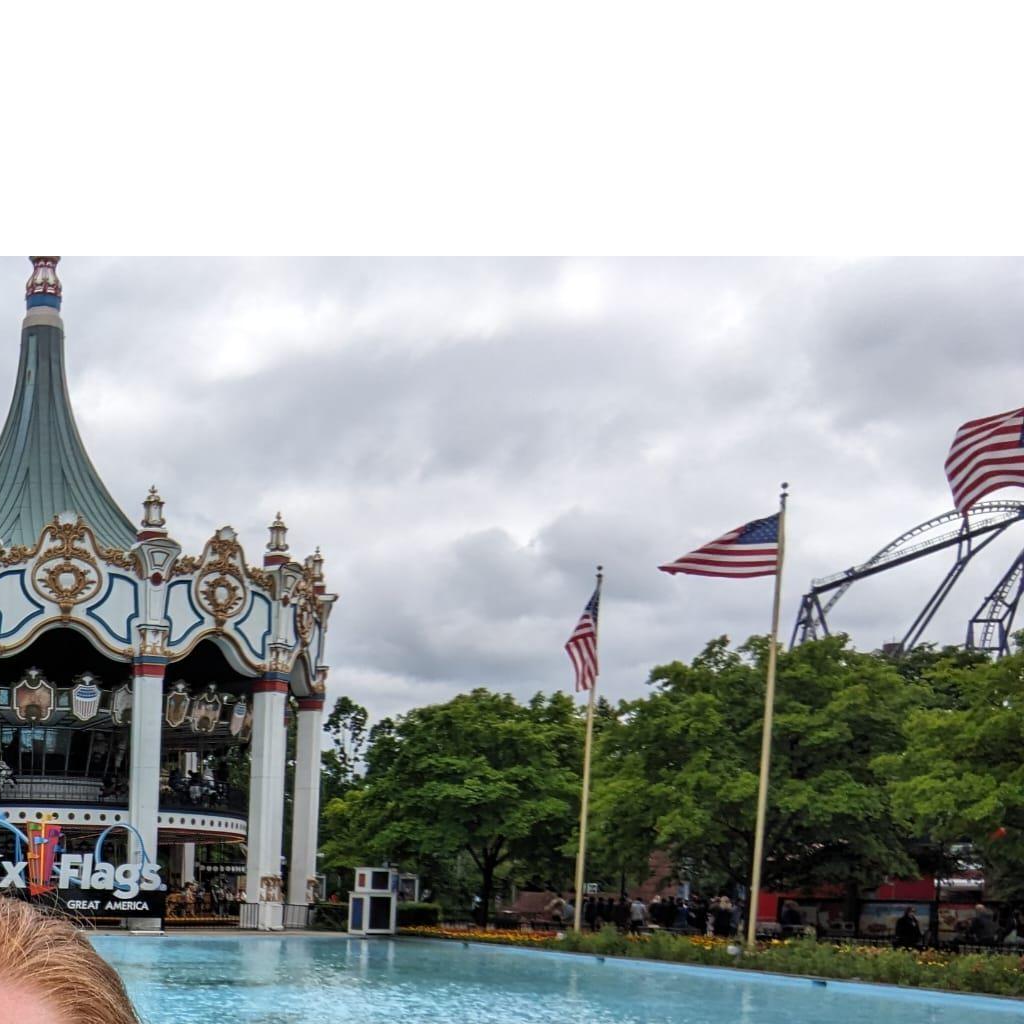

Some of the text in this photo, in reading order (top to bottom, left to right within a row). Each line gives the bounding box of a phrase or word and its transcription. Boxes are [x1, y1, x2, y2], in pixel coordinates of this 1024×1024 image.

[58, 853, 162, 899] Flags
[66, 899, 150, 911] GREAT AMERICA
